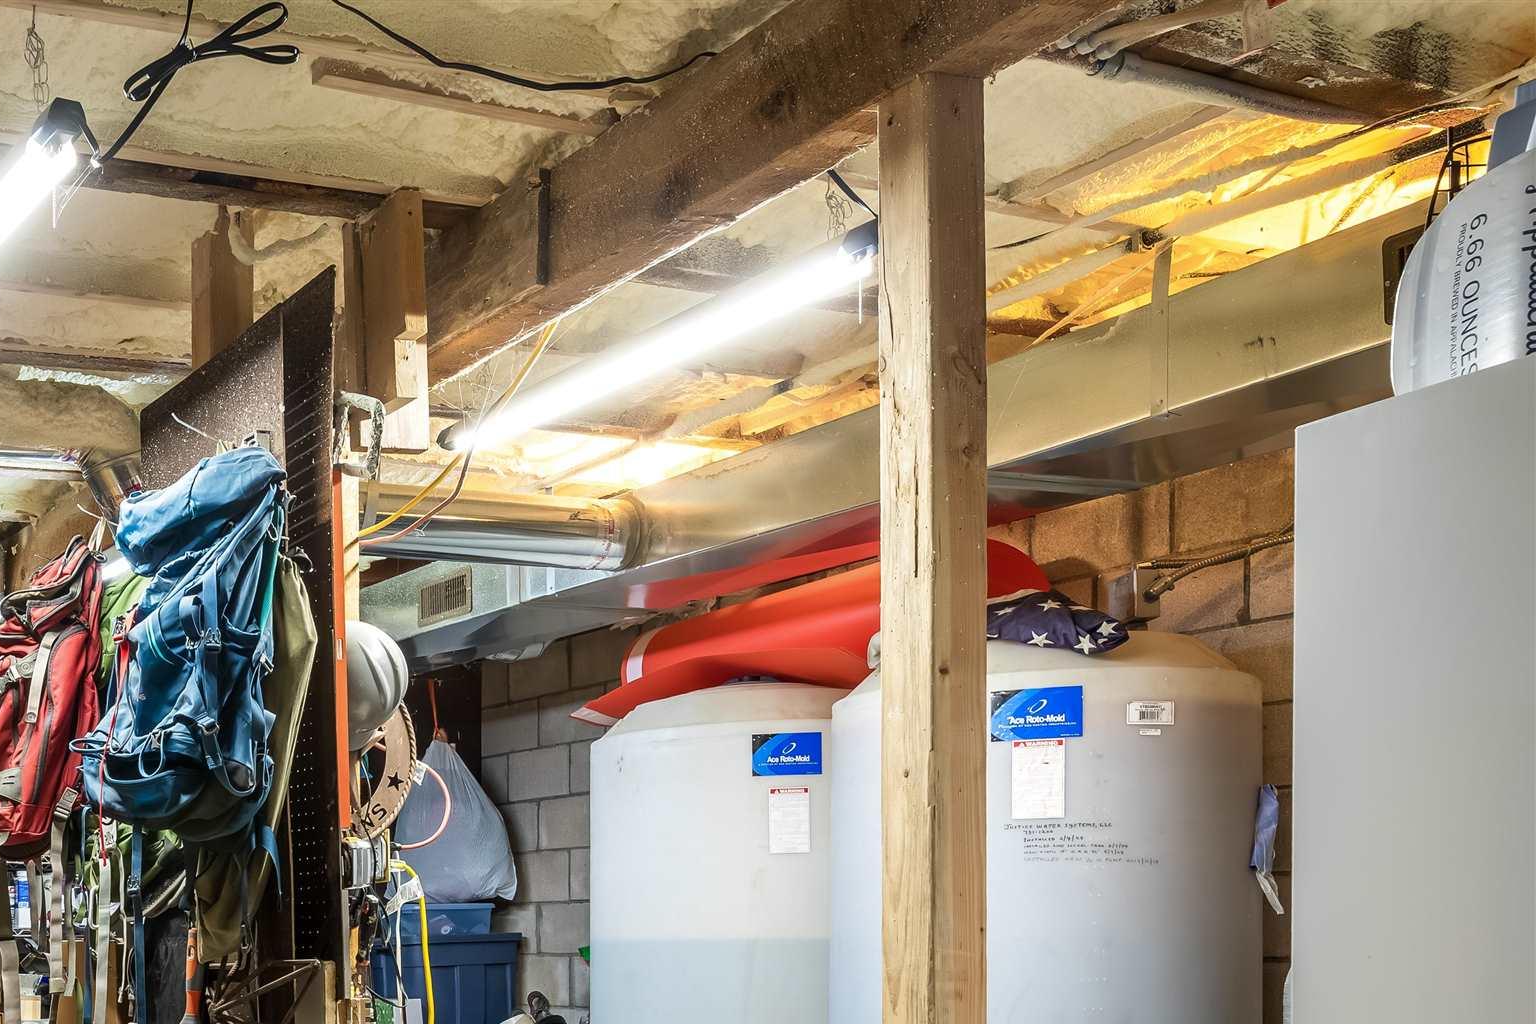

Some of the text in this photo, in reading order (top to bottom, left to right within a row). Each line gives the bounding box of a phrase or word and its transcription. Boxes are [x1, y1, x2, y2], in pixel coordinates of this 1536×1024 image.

[1455, 223, 1468, 267] PROUDLY
[1451, 270, 1462, 310] BREWED
[1461, 213, 1488, 376] 6.66 OUNCES
